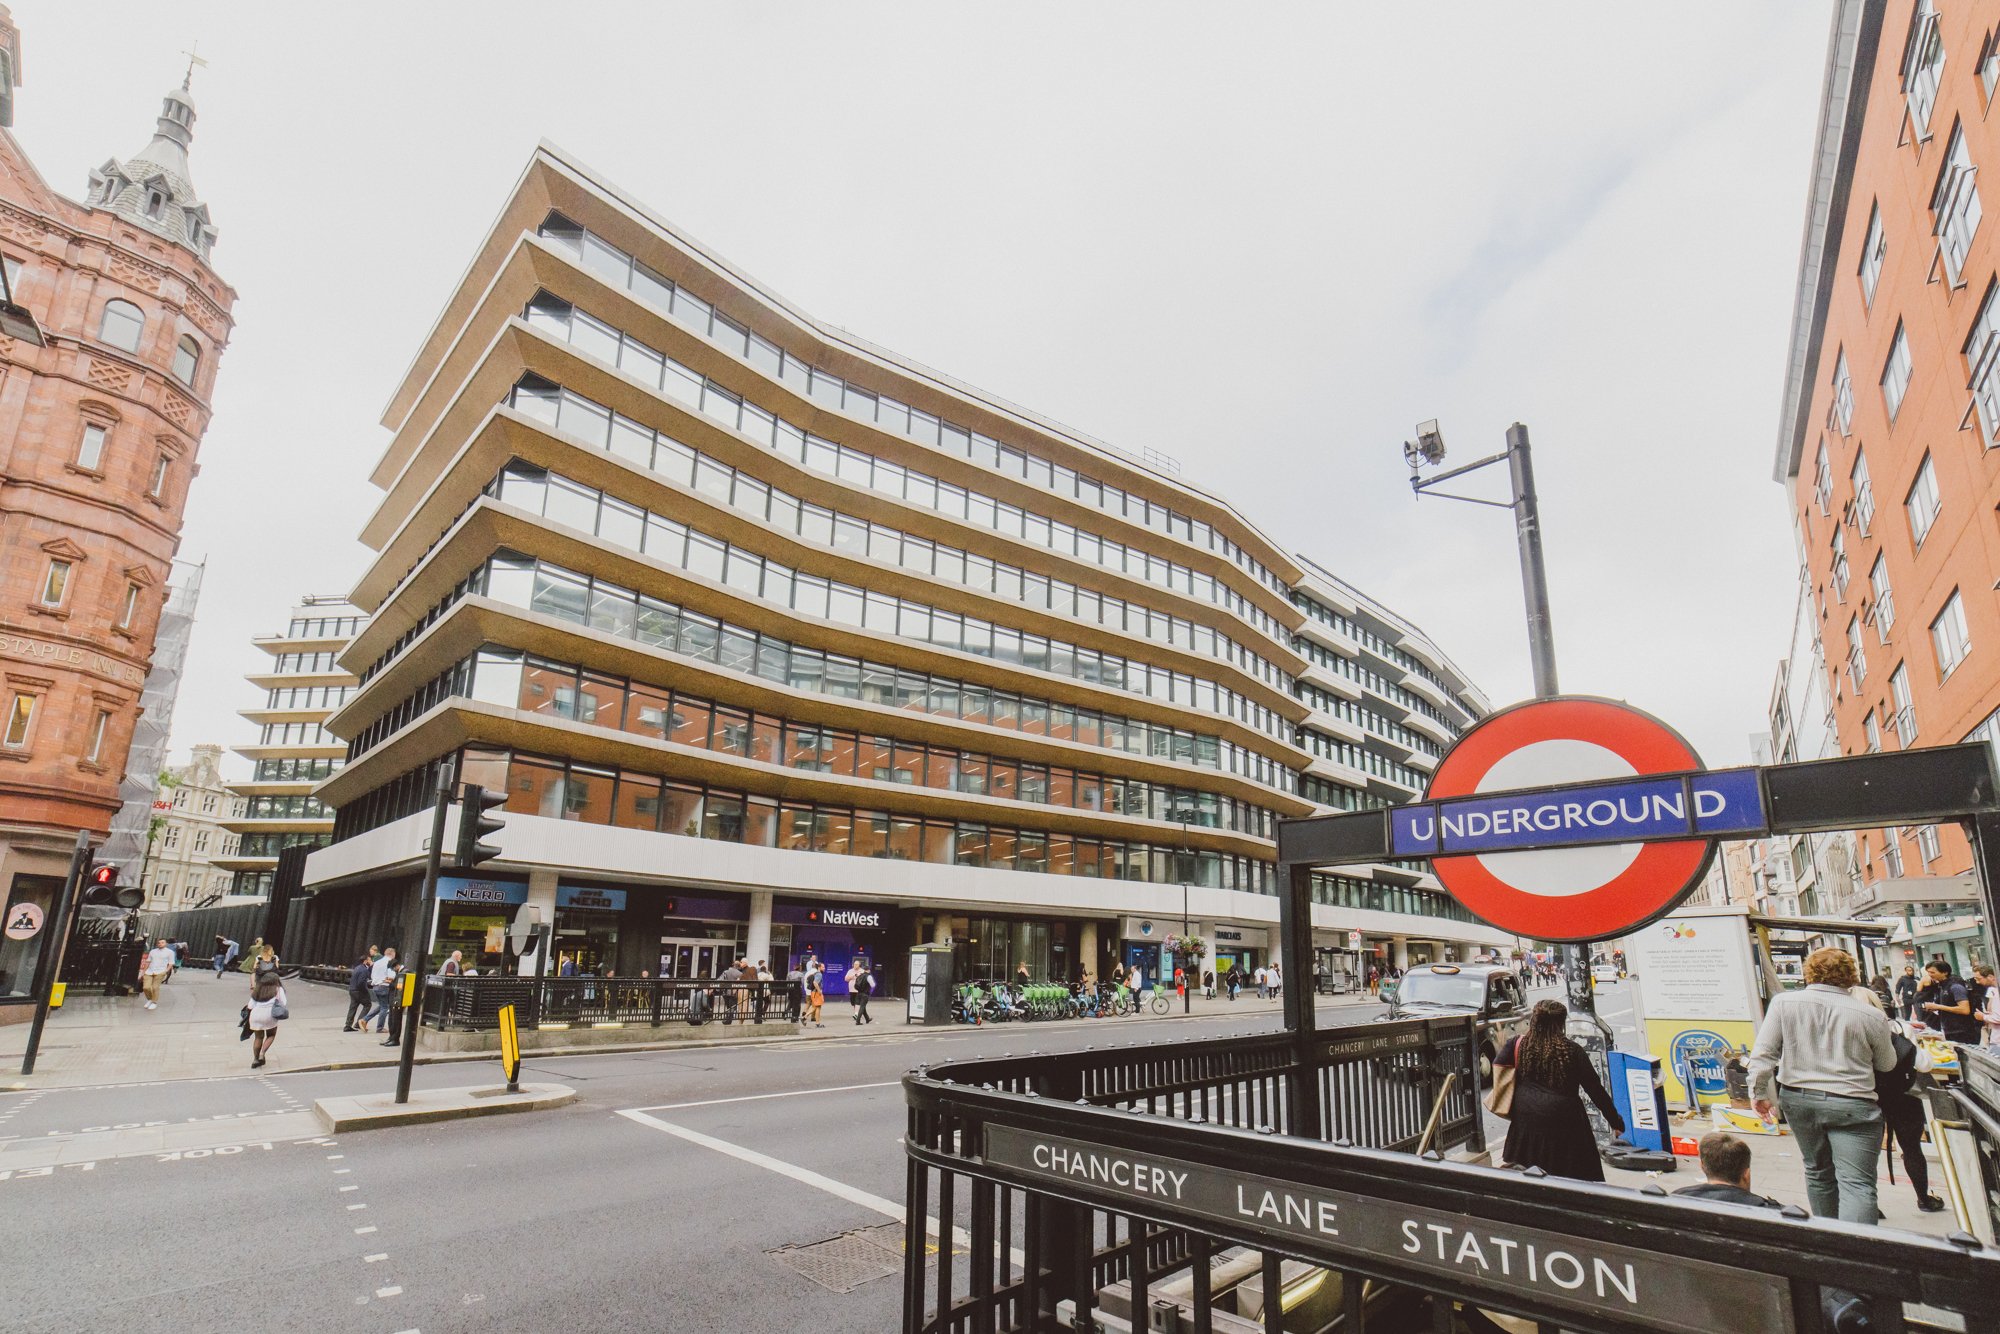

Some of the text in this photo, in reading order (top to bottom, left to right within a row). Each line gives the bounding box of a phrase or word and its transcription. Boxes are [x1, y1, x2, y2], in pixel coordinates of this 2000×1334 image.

[0, 637, 83, 664] STAPLE
[91, 656, 118, 676] INN
[1411, 789, 1727, 842] UNDERGROUND
[455, 889, 506, 902] NERO
[569, 895, 612, 908] NERO
[823, 909, 880, 927] NatWest
[1216, 930, 1242, 941] BARCLAYS
[1328, 1033, 1419, 1056] CHANCERY LANE STATION
[1633, 1075, 1650, 1102] CITY
[47, 1109, 293, 1136] LOOK LEFT
[155, 1142, 273, 1163] LOOK
[1032, 1144, 1638, 1304] CHANCERY LANE STATION
